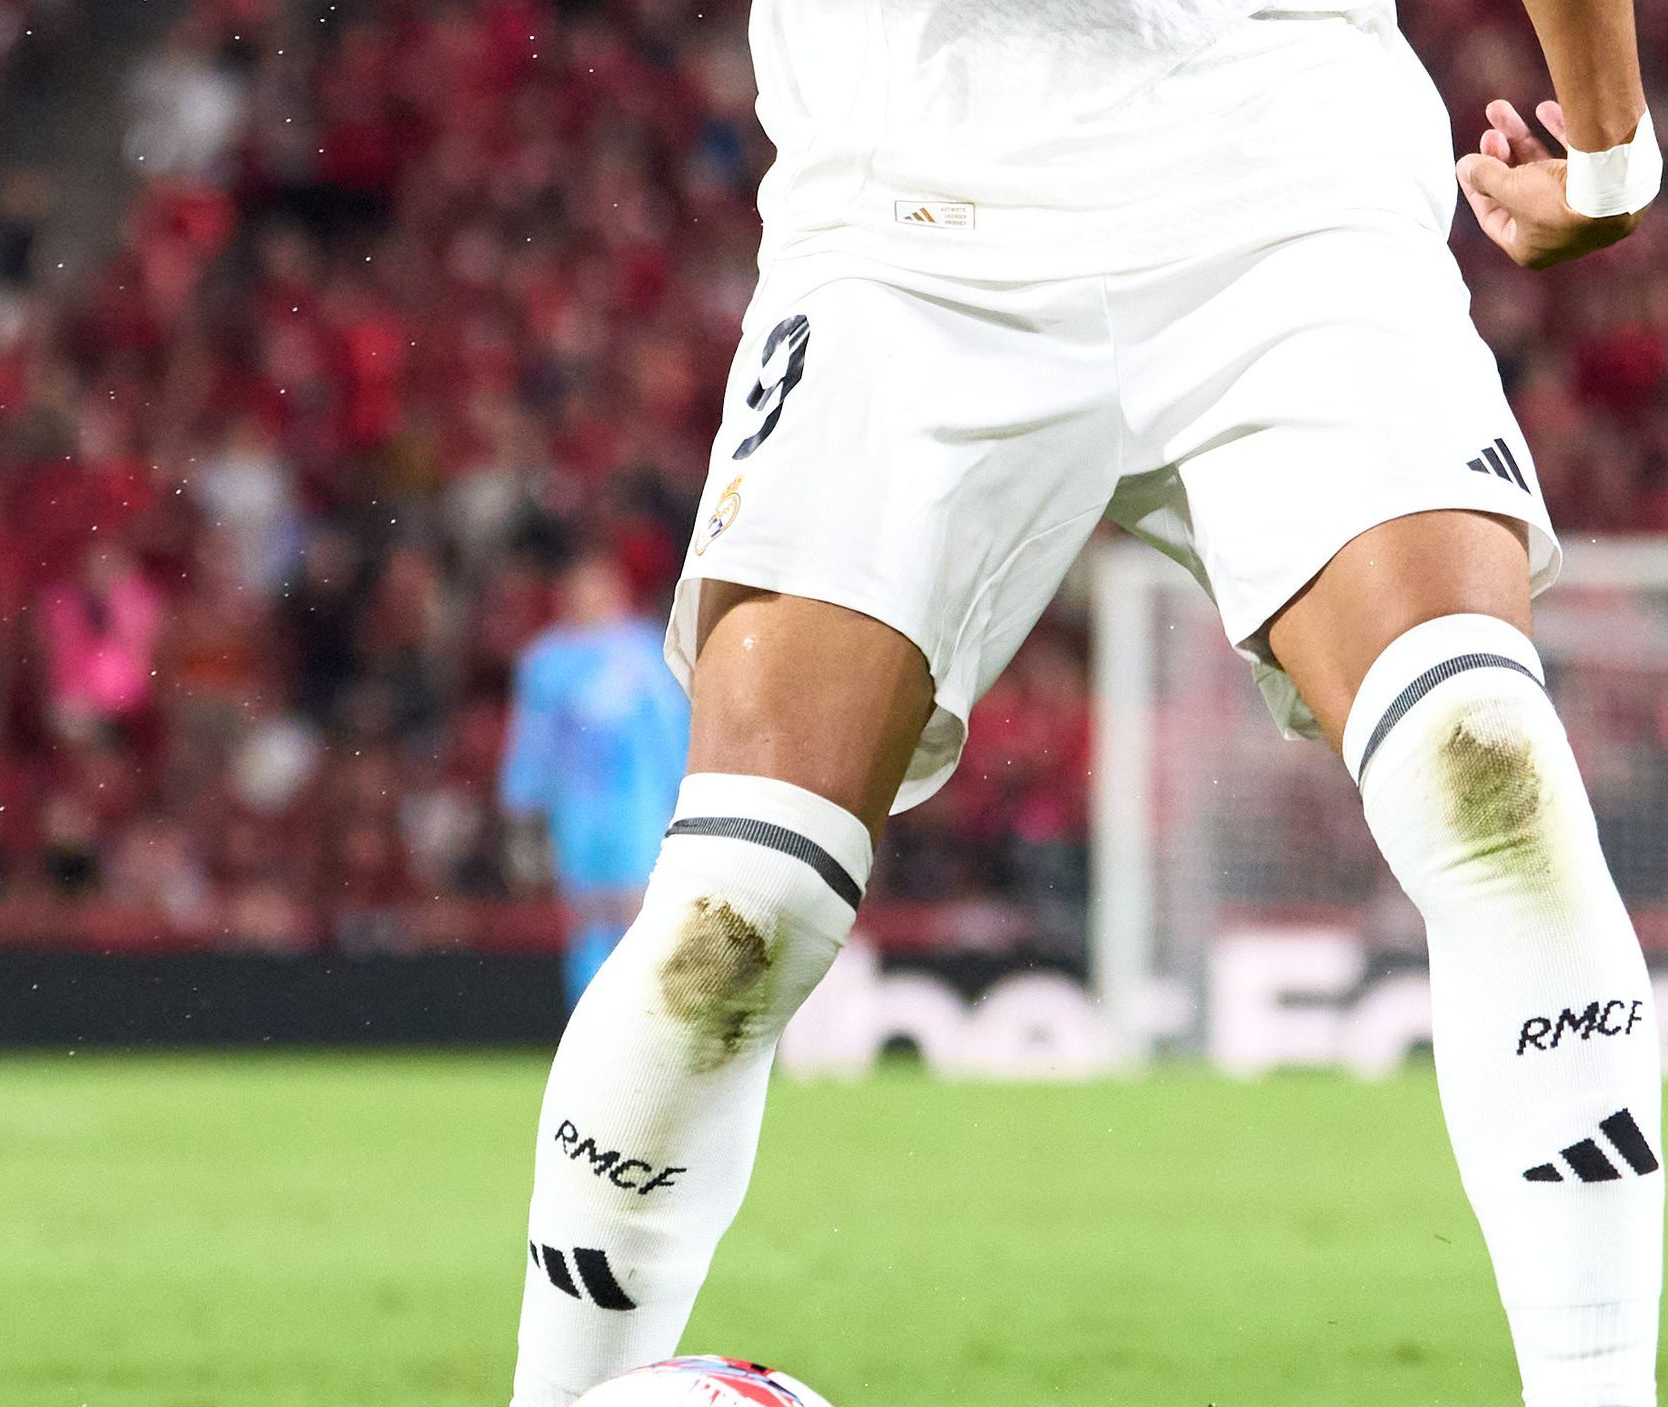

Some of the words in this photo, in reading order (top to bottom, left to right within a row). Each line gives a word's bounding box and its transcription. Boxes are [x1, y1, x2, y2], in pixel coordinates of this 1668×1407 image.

[732, 314, 810, 460] 9
[1516, 999, 1643, 1056] RMCF
[554, 1119, 688, 1195] RMCF
